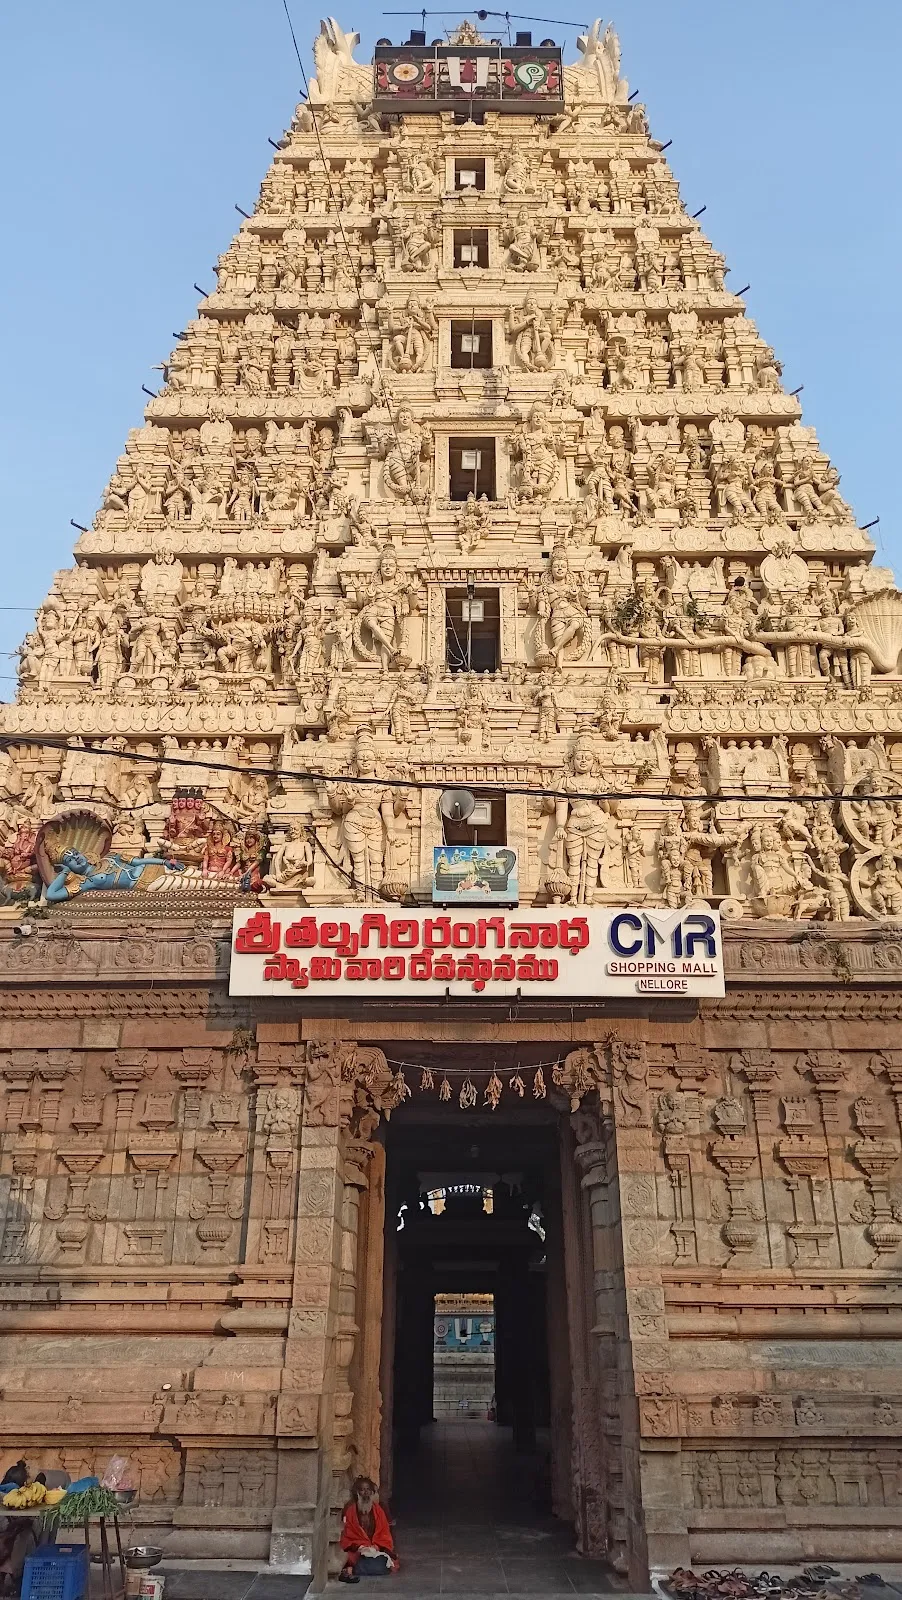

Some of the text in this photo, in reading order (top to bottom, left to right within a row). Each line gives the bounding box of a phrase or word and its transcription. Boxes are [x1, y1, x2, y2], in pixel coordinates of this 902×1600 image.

[235, 912, 281, 954] శ్రీ
[285, 913, 419, 957] తల్పగిరి
[608, 906, 717, 958] CMR
[610, 962, 718, 973] SHOPPING MALL
[640, 979, 688, 989] NELLORE
